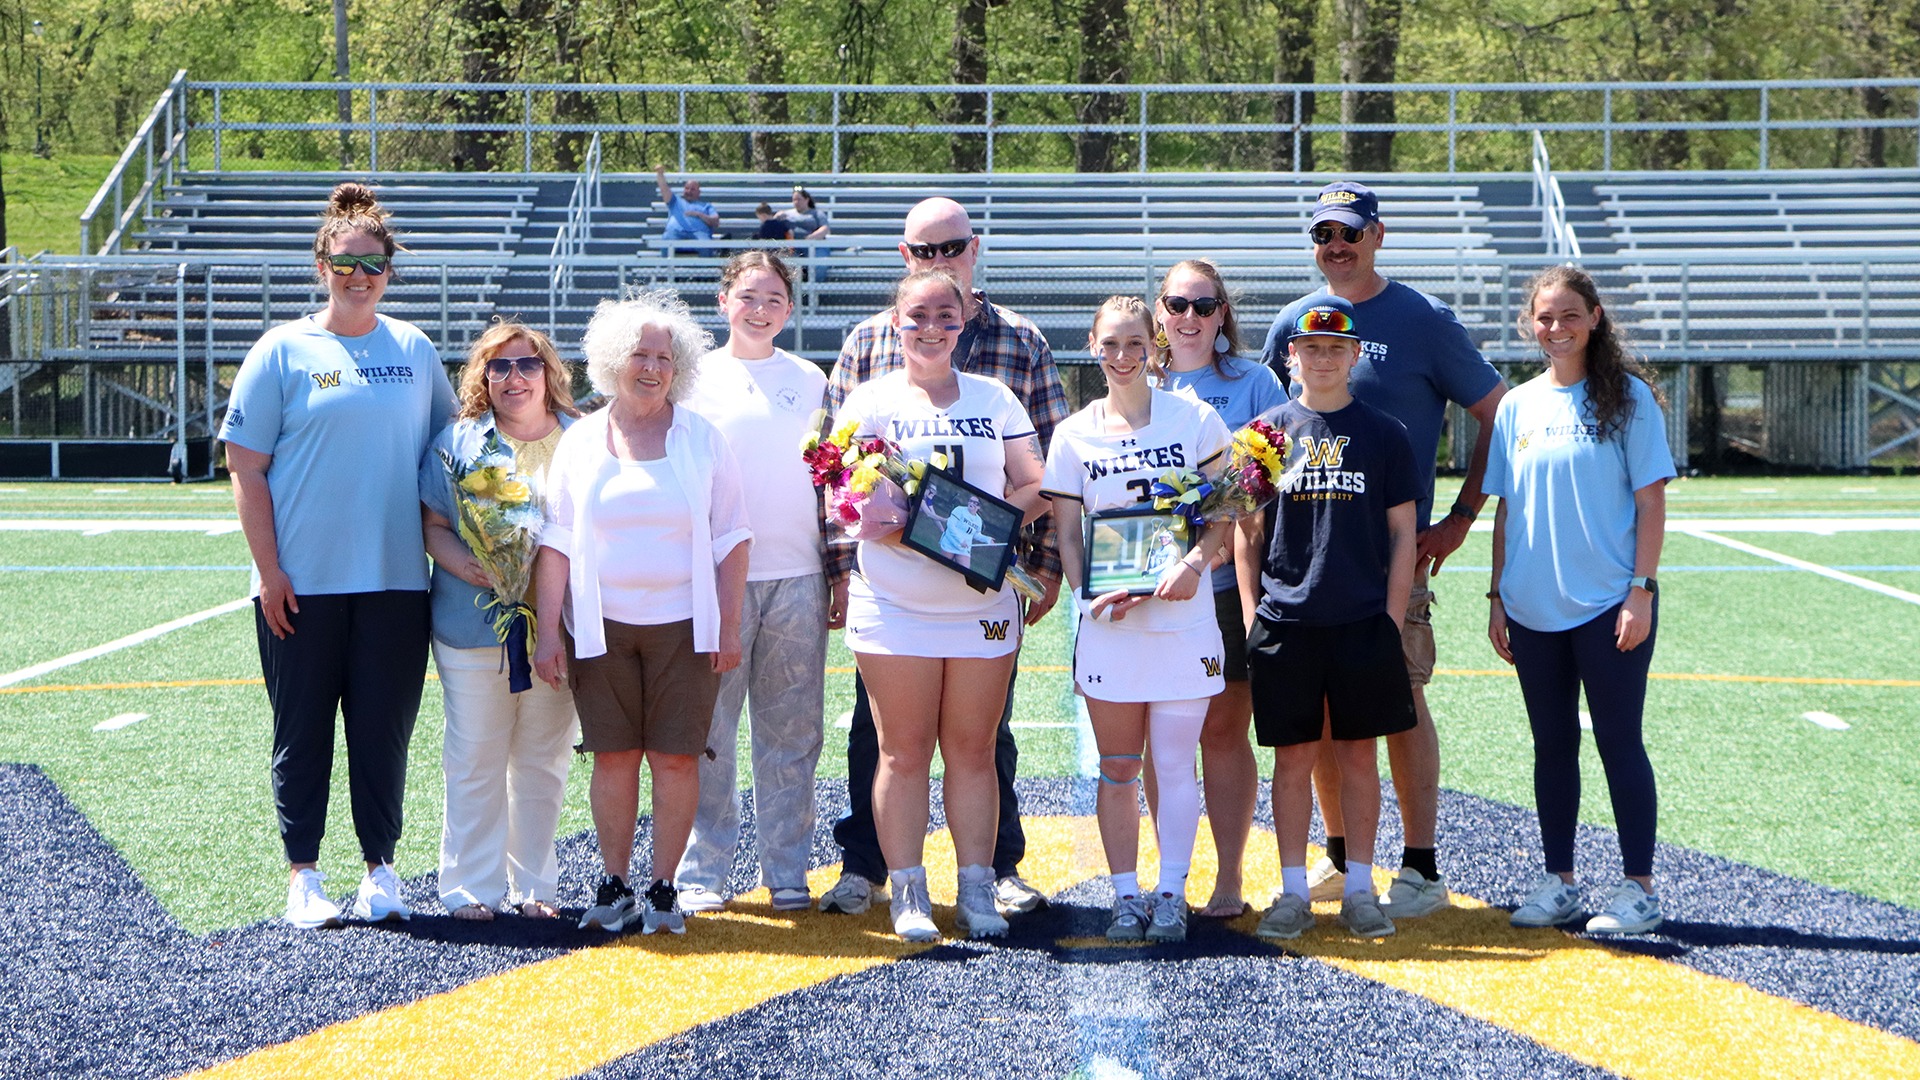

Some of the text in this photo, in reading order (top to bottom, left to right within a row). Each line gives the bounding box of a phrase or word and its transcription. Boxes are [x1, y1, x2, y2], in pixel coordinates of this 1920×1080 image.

[1360, 340, 1388, 355] KES
[312, 370, 341, 389] W
[355, 366, 413, 378] WILKES
[892, 417, 997, 441] WILKES
[1083, 443, 1186, 481] WILKES
[1299, 435, 1351, 469] W
[1282, 470, 1366, 494] WILKES
[1292, 492, 1353, 502] UNIVERSITY
[979, 619, 1010, 641] W
